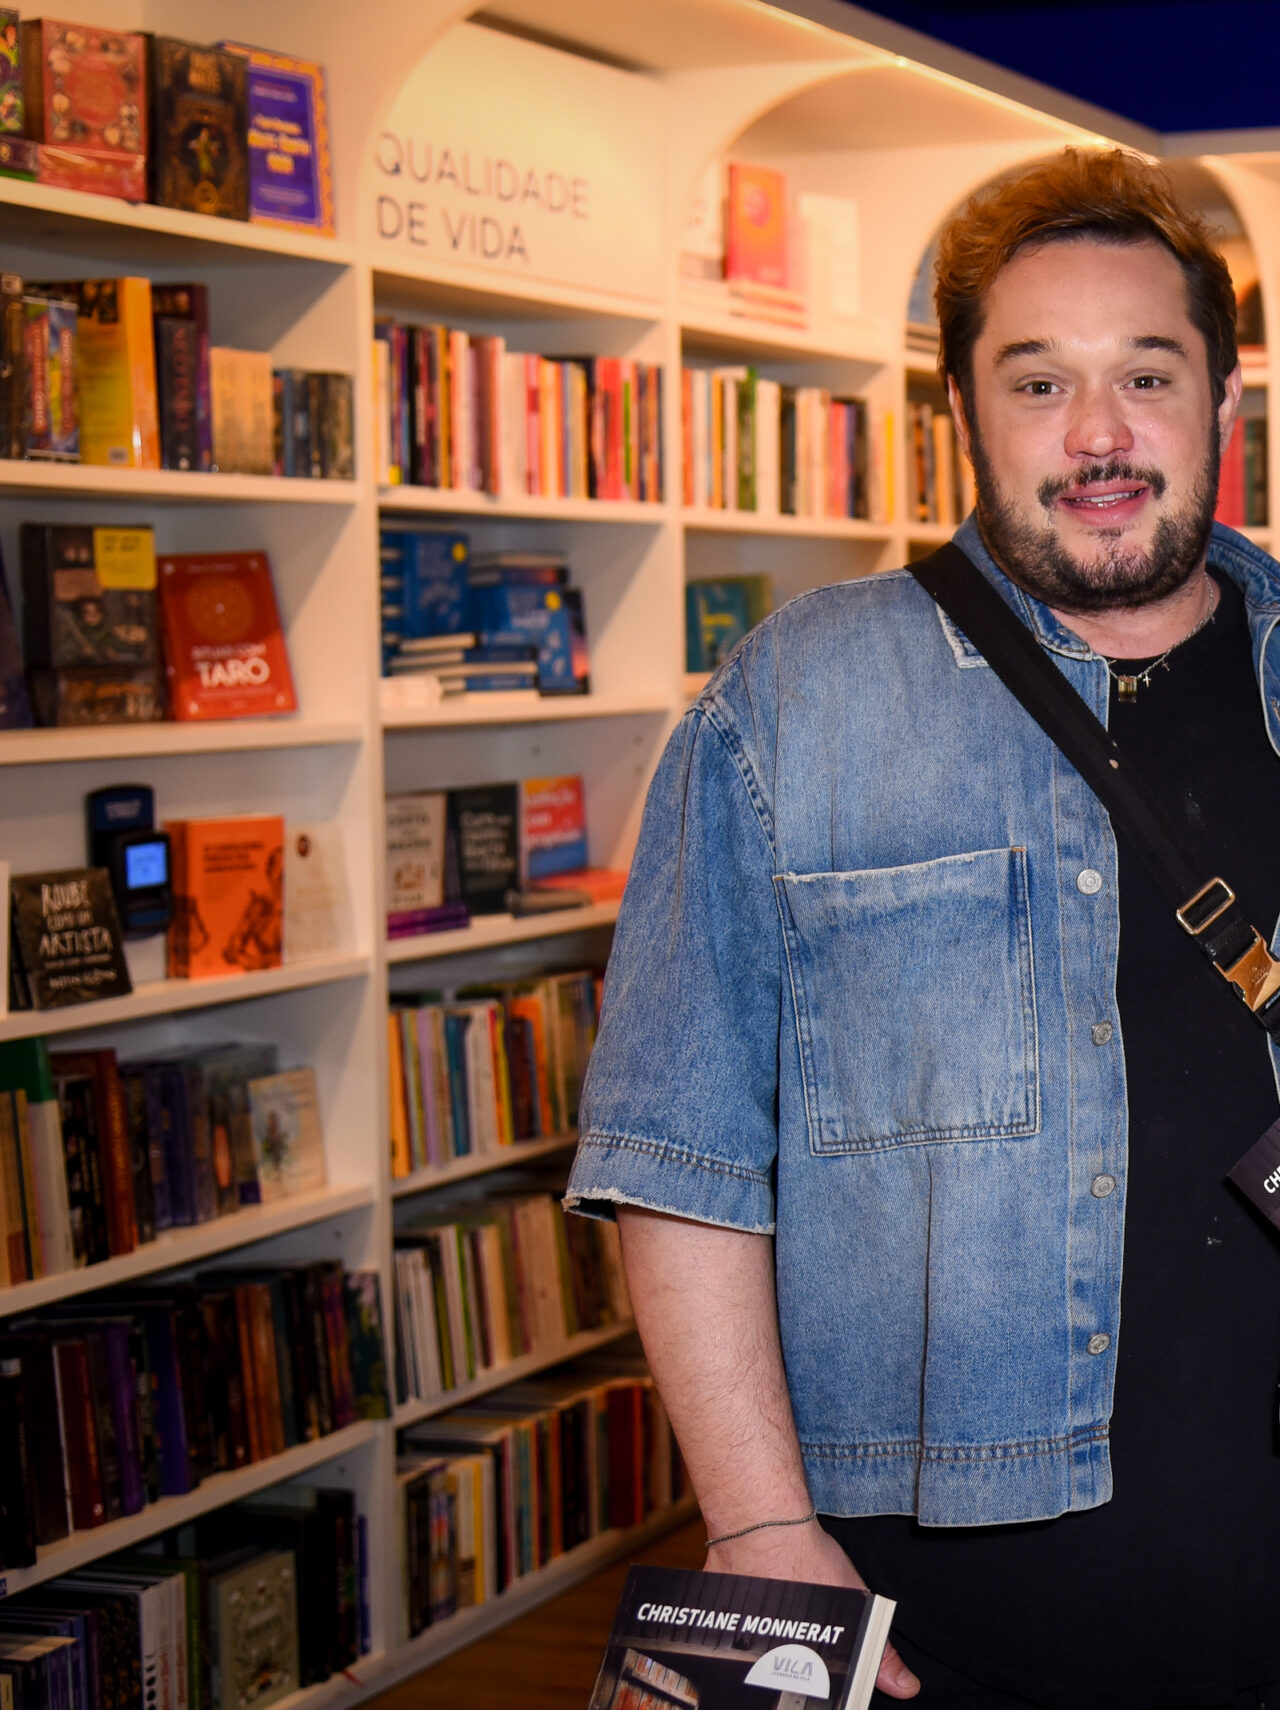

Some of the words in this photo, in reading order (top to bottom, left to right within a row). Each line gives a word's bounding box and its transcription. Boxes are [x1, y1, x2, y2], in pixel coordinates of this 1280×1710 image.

[376, 131, 590, 220] QUALIDADE
[377, 194, 427, 246] DE
[441, 207, 530, 263] VIDA
[40, 926, 114, 957] ARTISTA
[637, 1603, 740, 1631] CHRISTIANE
[741, 1615, 845, 1645] MONNERAT
[774, 1656, 813, 1677] VILA
